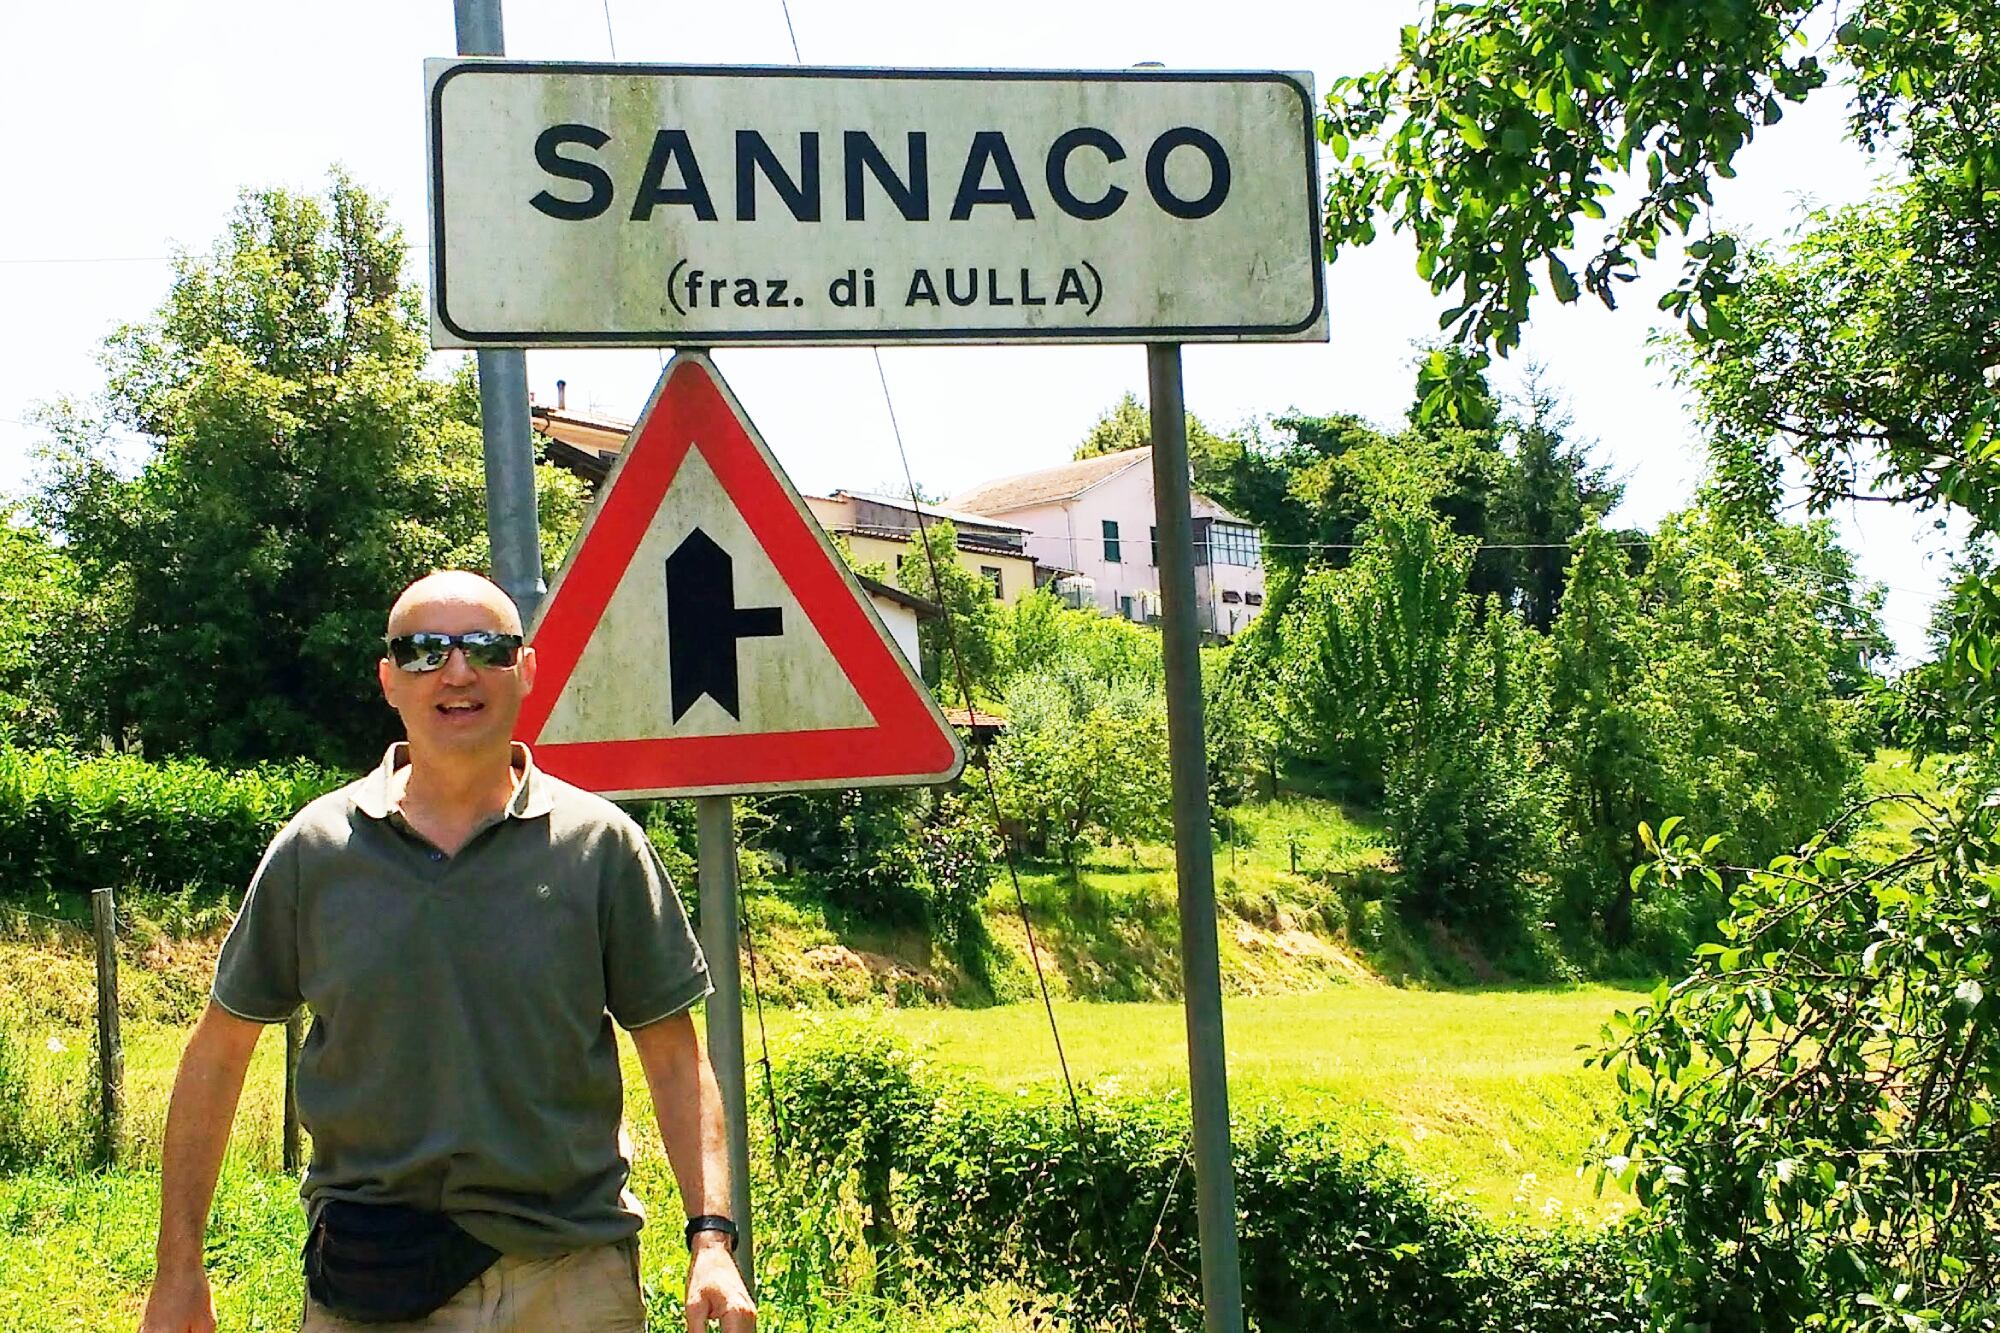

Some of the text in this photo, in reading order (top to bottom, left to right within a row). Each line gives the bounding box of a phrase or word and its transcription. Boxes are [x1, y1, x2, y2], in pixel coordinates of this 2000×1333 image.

[528, 123, 1231, 223] SANNACO
[667, 258, 1103, 317] (fraz. di AULLA)
